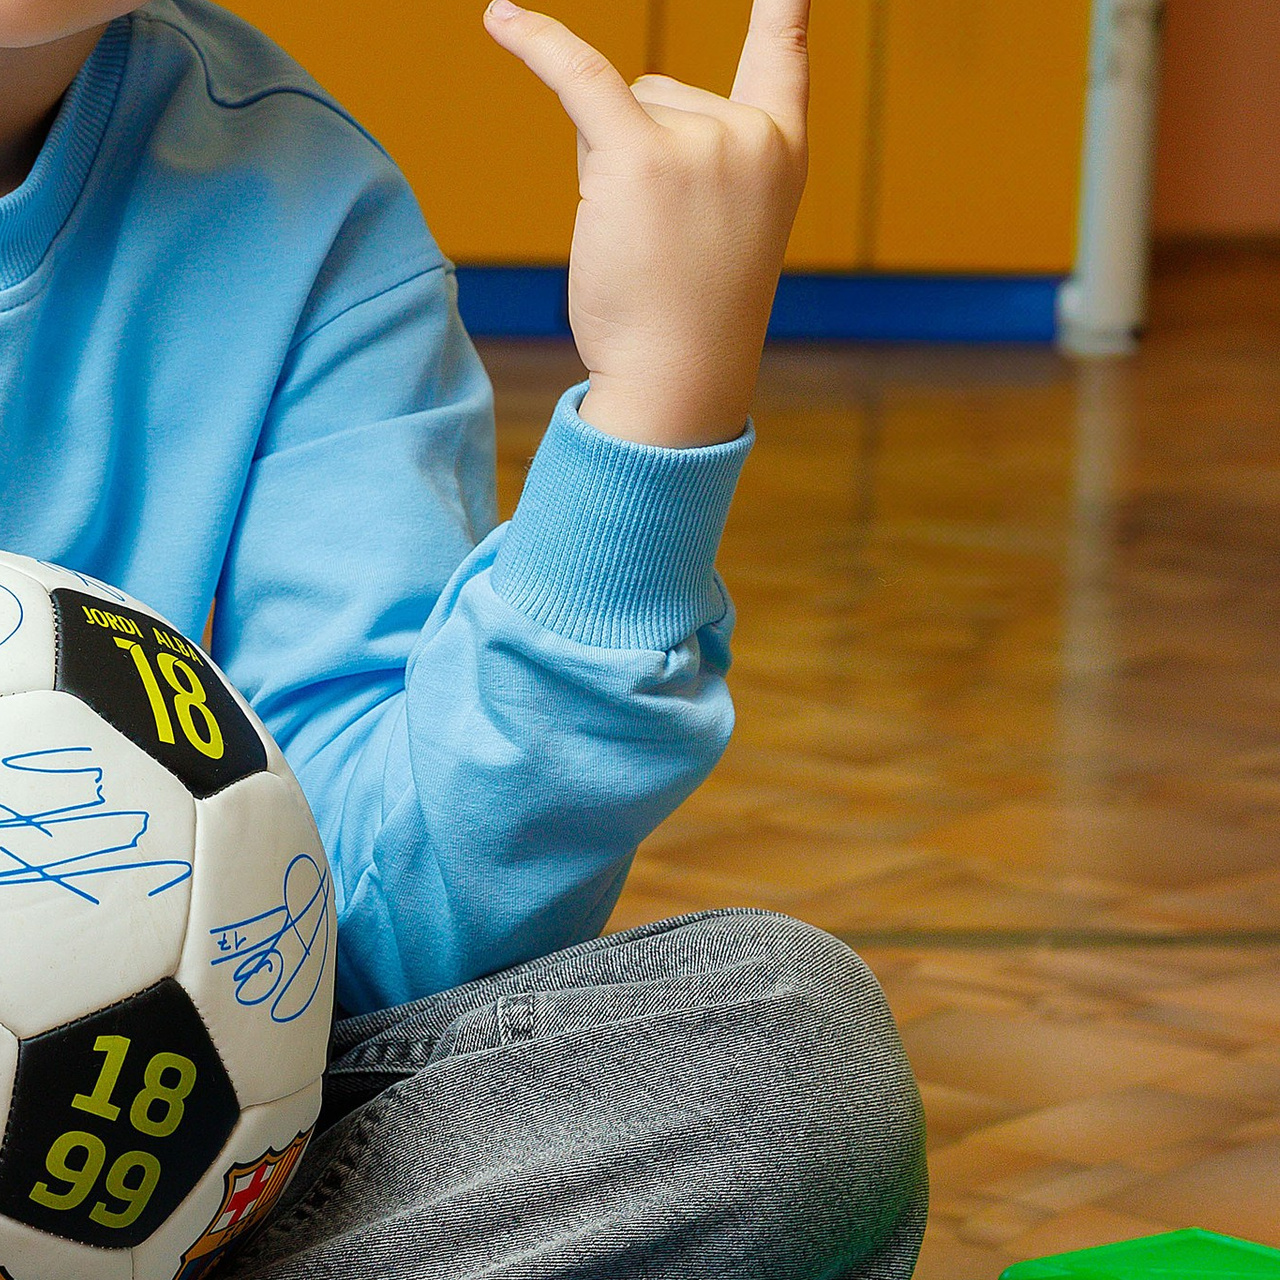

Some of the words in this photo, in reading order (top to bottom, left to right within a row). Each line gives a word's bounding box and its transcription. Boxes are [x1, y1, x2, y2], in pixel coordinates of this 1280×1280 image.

[81, 605, 144, 639] JORDI
[151, 627, 204, 667] ALBA
[113, 636, 224, 760] 18
[70, 1034, 198, 1138] 18
[28, 1130, 162, 1229] 99
